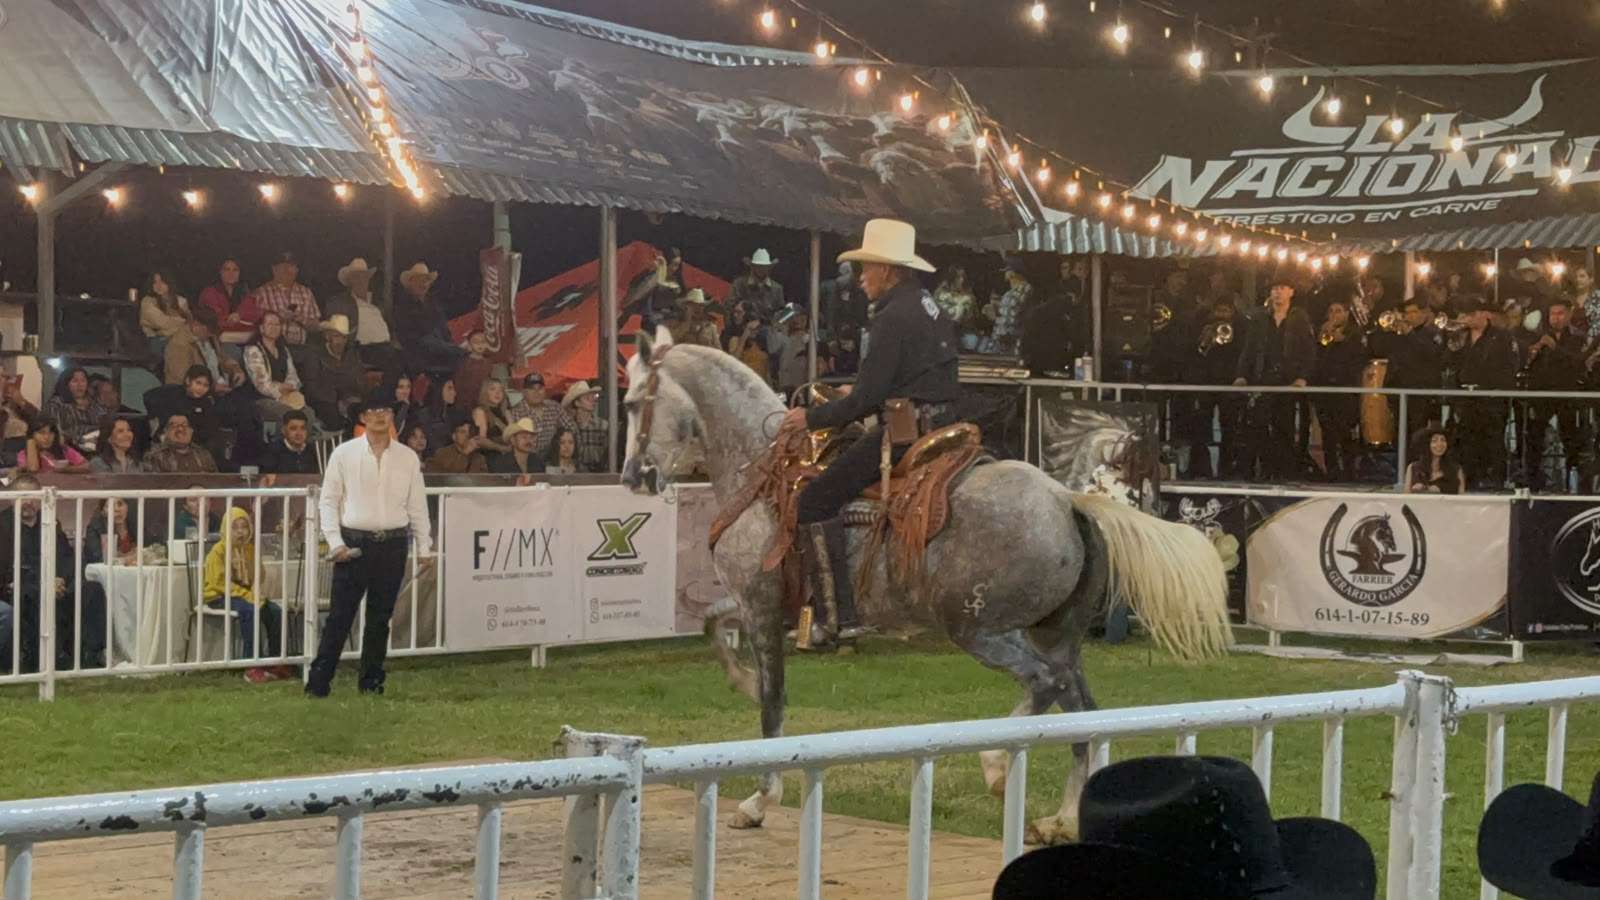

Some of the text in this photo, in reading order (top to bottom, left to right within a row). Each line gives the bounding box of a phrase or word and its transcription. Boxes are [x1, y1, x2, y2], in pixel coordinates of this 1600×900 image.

[1347, 111, 1463, 153] LA
[1130, 135, 1600, 208] NACIONAL
[1214, 200, 1499, 225] PRESTIGIO EN CARNE
[1328, 570, 1377, 601] GERARDO
[1351, 576, 1393, 585] FARRIER
[1314, 607, 1430, 626] 614-1-07-15-89
